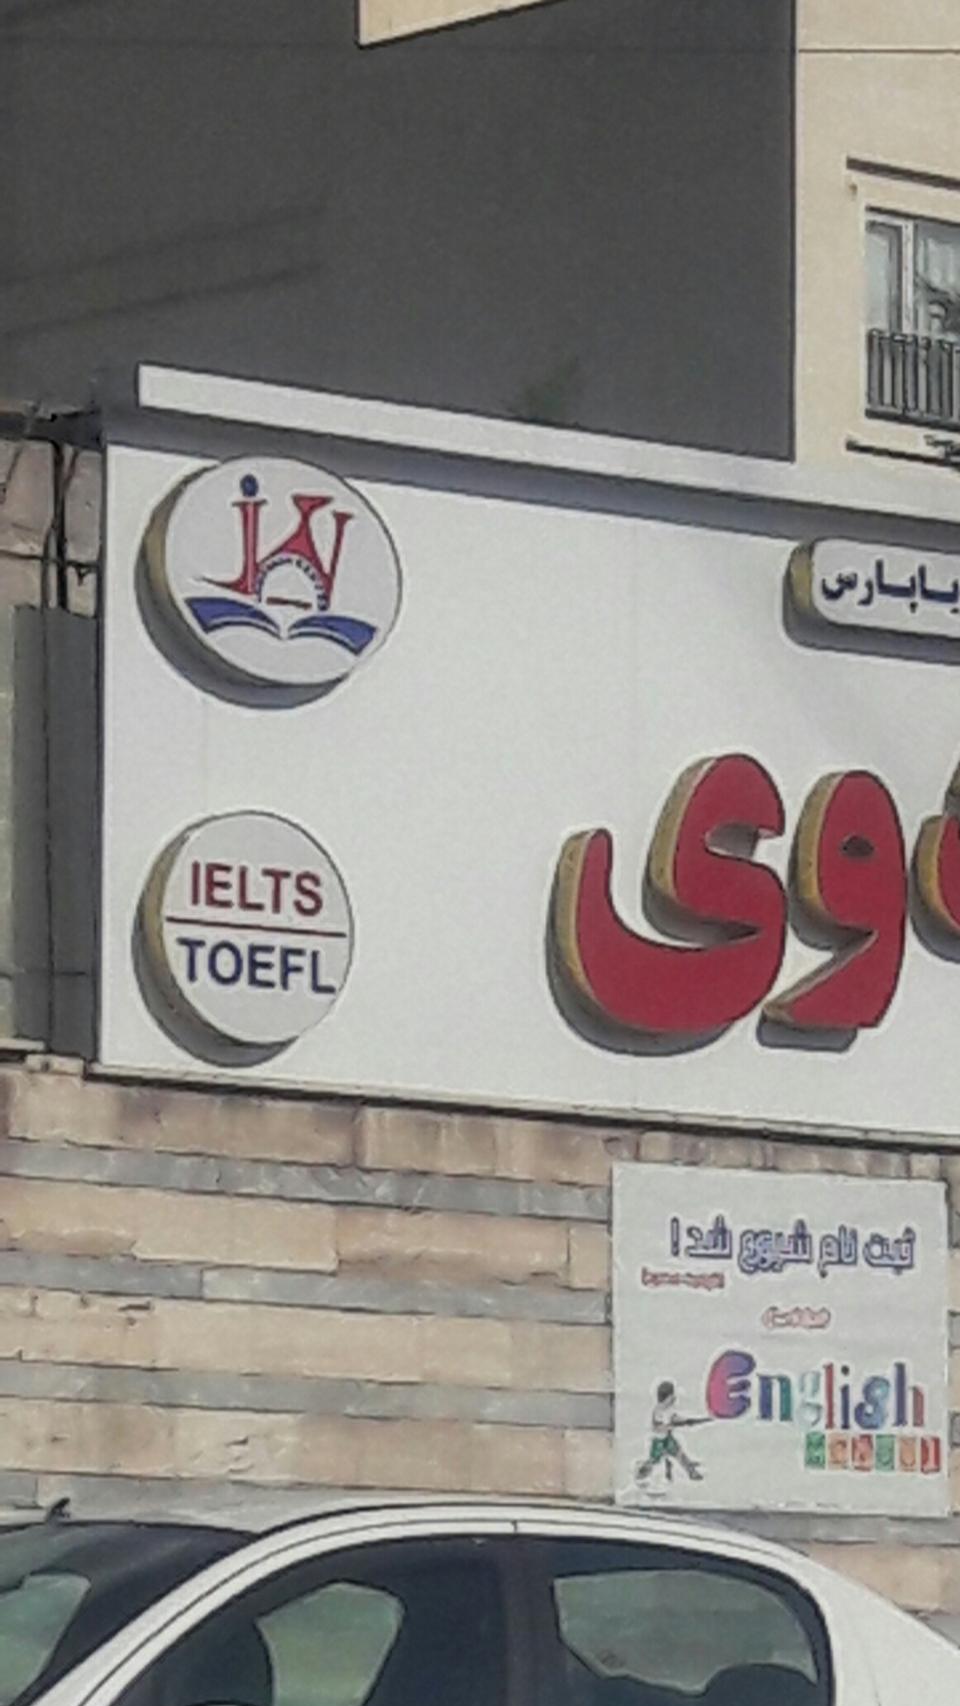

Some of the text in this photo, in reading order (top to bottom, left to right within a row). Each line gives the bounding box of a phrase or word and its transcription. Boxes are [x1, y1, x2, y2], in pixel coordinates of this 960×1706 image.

[191, 861, 324, 917] IELTS
[176, 937, 337, 994] TOEFL
[817, 1224, 858, 1279] نام
[862, 1226, 917, 1276] ثبت
[705, 1349, 925, 1430] English
